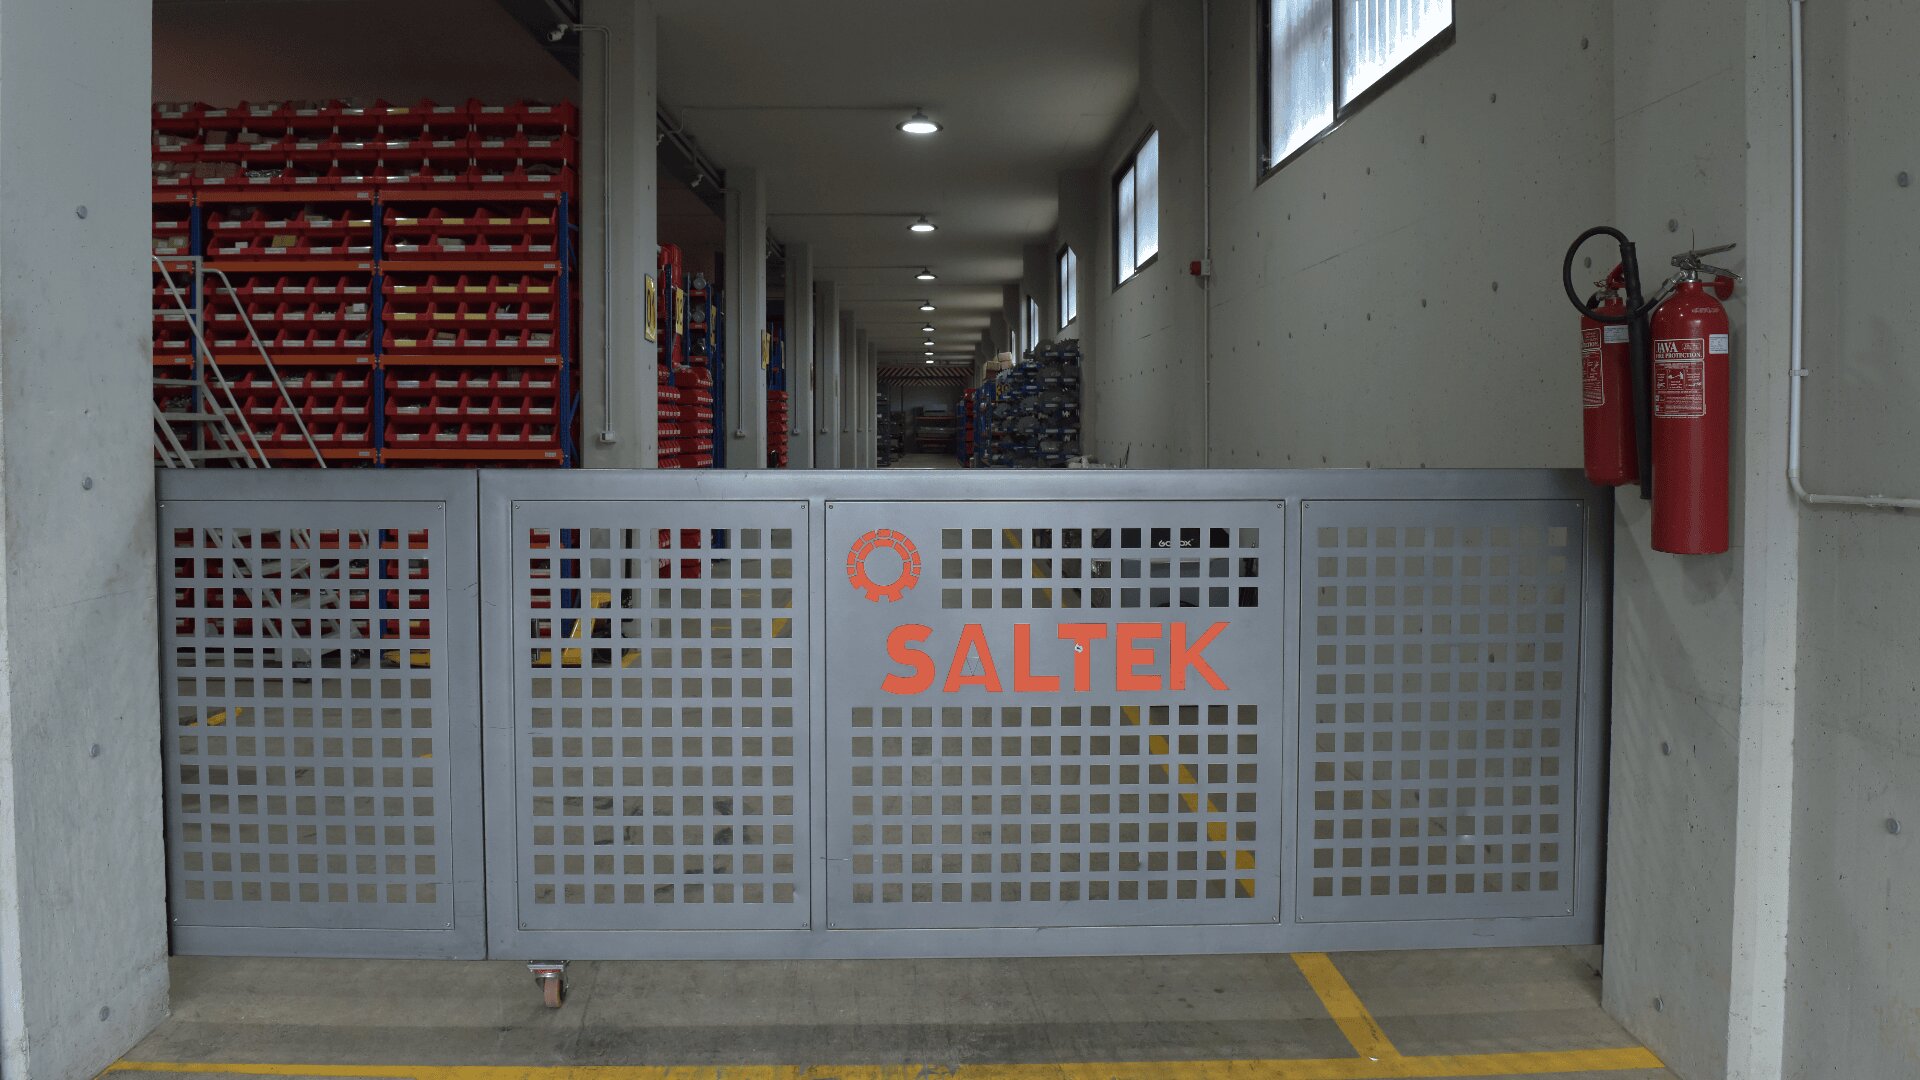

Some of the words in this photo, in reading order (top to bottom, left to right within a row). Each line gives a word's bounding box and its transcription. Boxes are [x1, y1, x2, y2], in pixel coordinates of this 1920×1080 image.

[1657, 341, 1678, 353] JAVA
[1158, 539, 1192, 547] GOOX
[880, 621, 1231, 696] SALTEK
